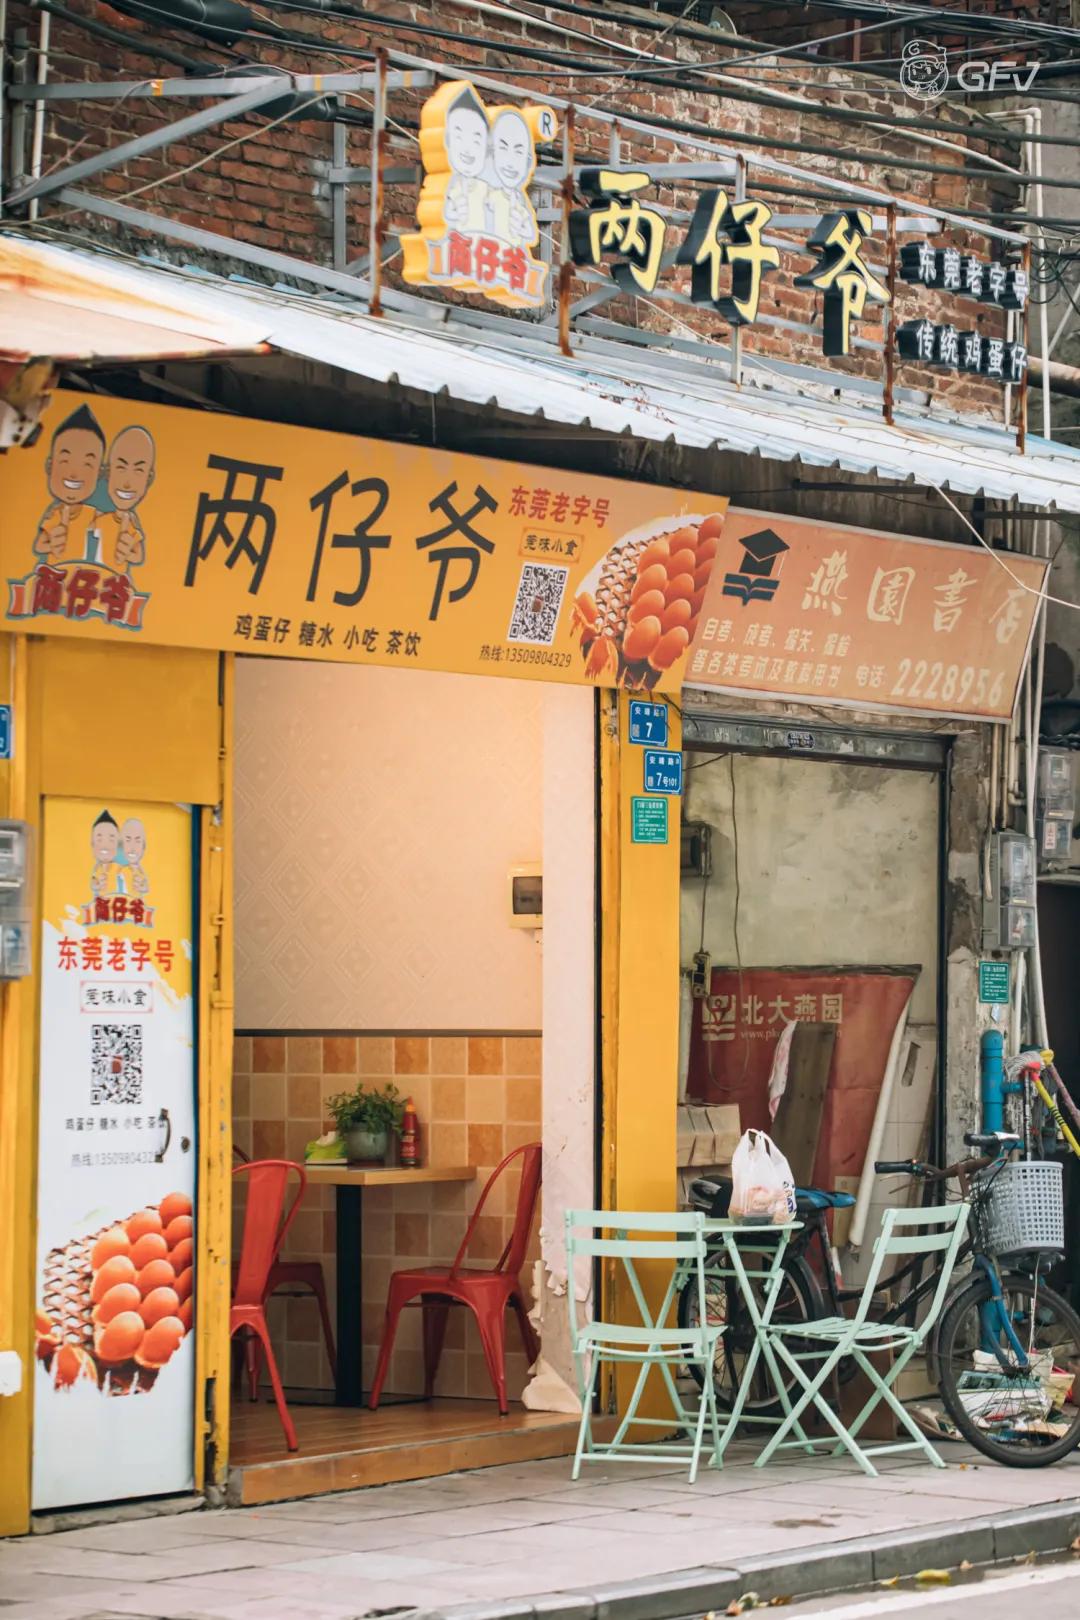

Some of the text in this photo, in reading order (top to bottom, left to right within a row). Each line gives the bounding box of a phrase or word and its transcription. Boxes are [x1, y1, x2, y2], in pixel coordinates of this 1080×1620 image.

[447, 230, 528, 289] 两仔爷
[589, 169, 892, 356] 两仔爷
[917, 243, 1029, 311] 东莞老字号
[915, 322, 1028, 383] 传统鸡蛋仔
[508, 485, 611, 529] 东莞老字号
[184, 453, 499, 622] 两仔爷
[524, 534, 578, 557] 莞味小食
[32, 564, 131, 624] 两仔爷
[234, 613, 421, 657] 鸡蛋仔 糖水 小吃 茶饮
[890, 657, 1007, 708] 2228956
[645, 721, 653, 738] 7
[58, 936, 175, 972] 东莞老字号
[741, 993, 843, 1025] 北大燕园
